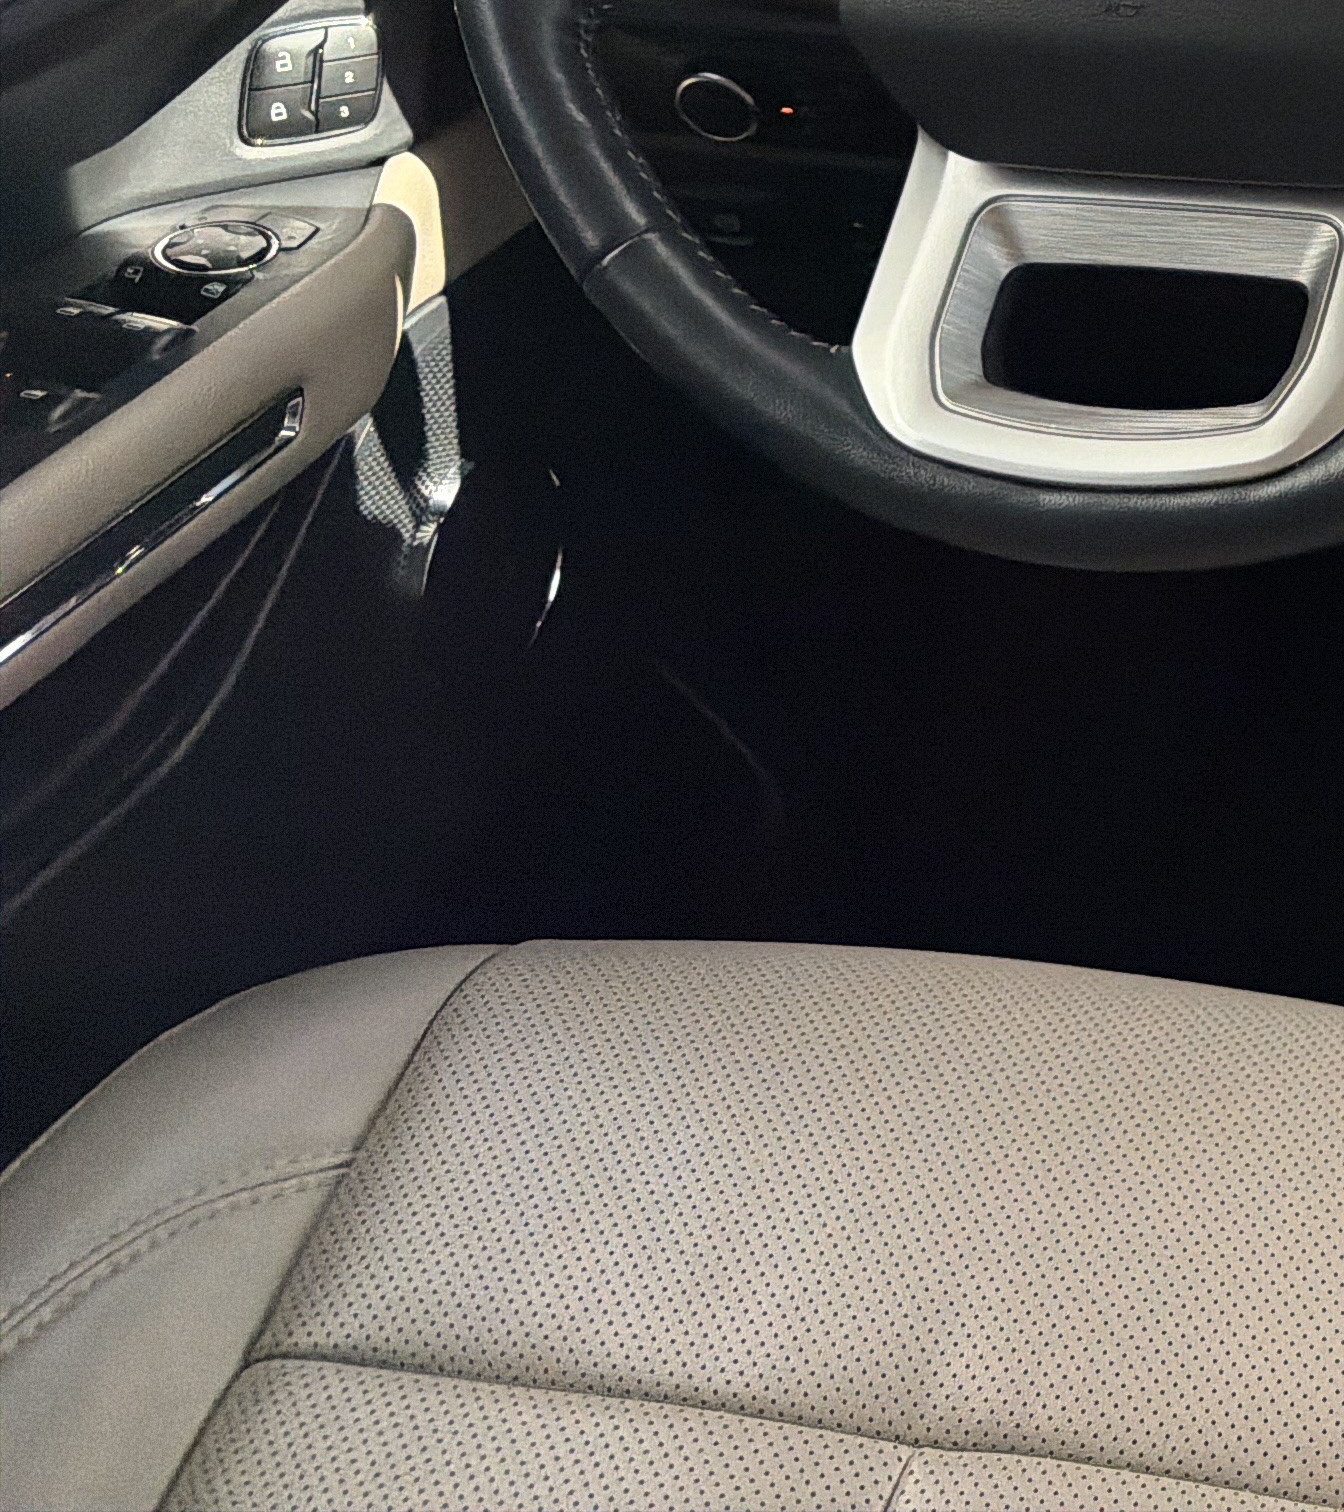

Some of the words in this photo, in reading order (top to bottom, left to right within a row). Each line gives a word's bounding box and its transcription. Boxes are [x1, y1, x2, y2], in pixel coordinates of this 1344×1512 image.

[347, 36, 356, 50] 1
[344, 70, 355, 84] 2
[339, 105, 350, 118] 3
